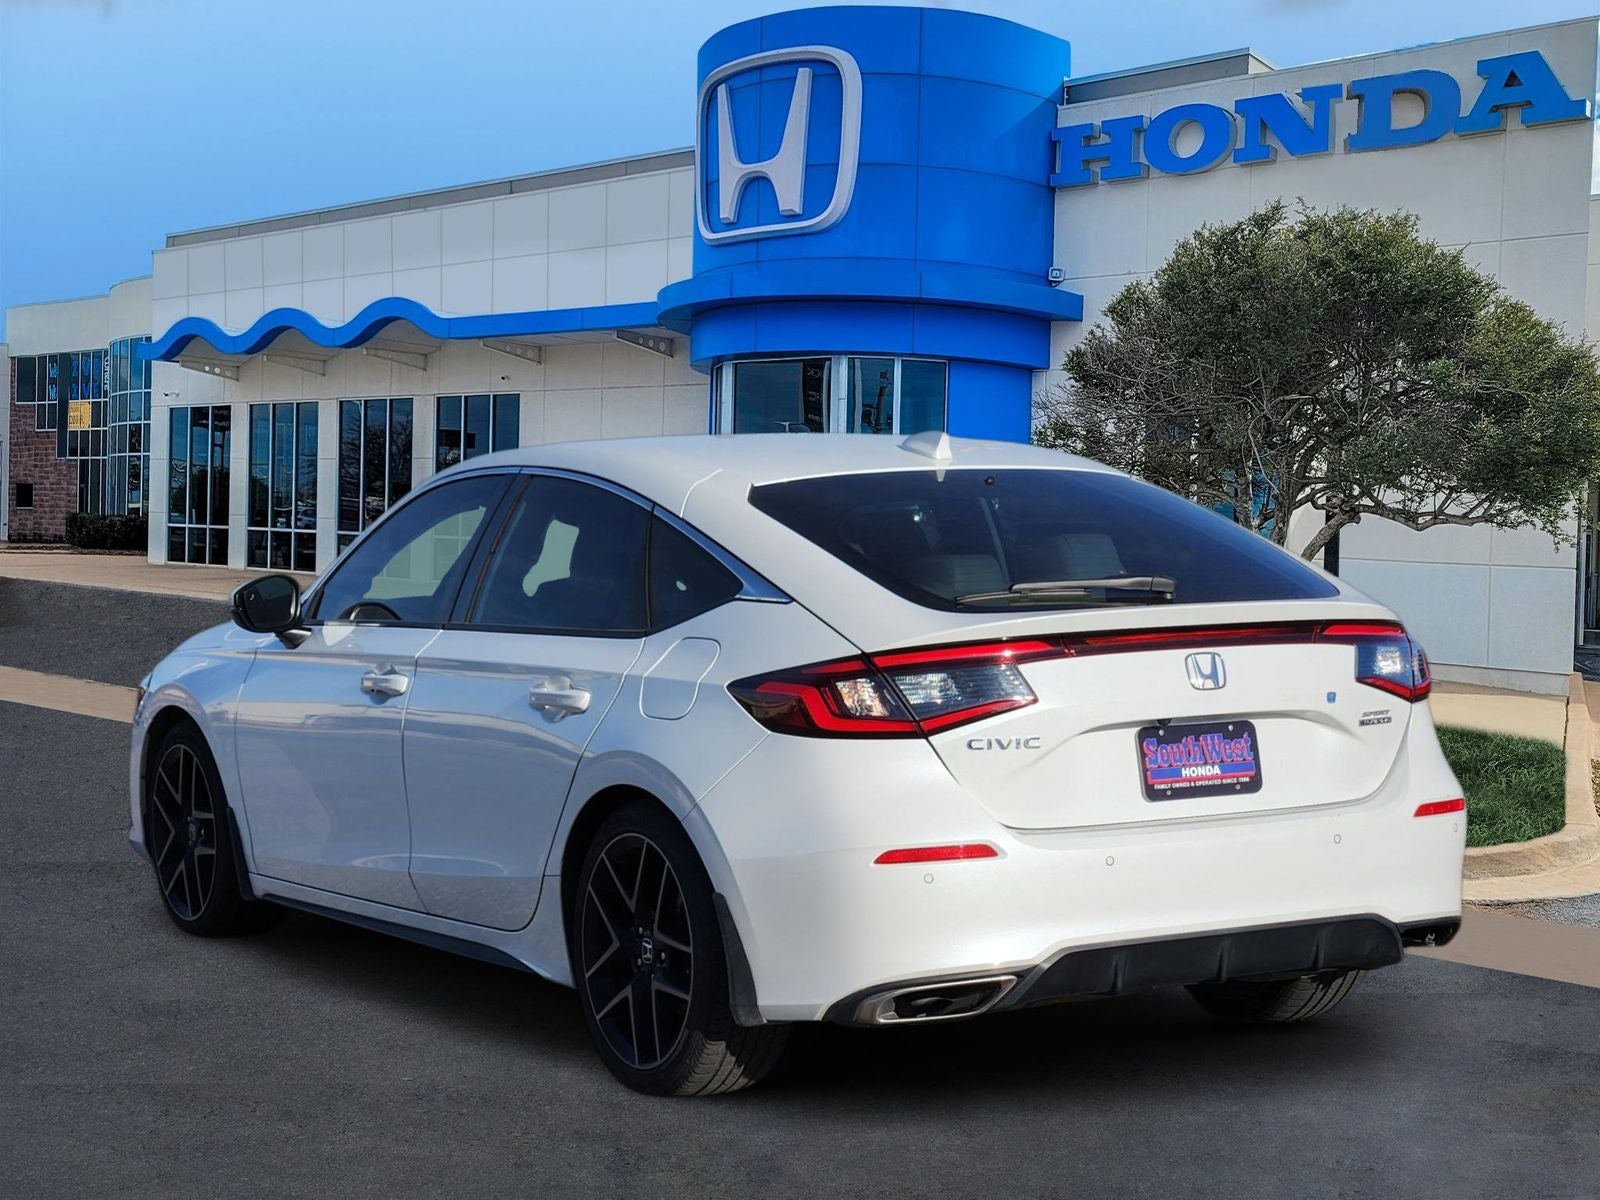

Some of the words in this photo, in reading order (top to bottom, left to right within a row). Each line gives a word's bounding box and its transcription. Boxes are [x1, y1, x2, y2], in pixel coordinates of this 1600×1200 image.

[1050, 50, 1591, 189] HONDA
[967, 736, 1041, 751] CIVIC
[1181, 765, 1221, 777] HONDA
[1195, 779, 1221, 787] OPERATED
